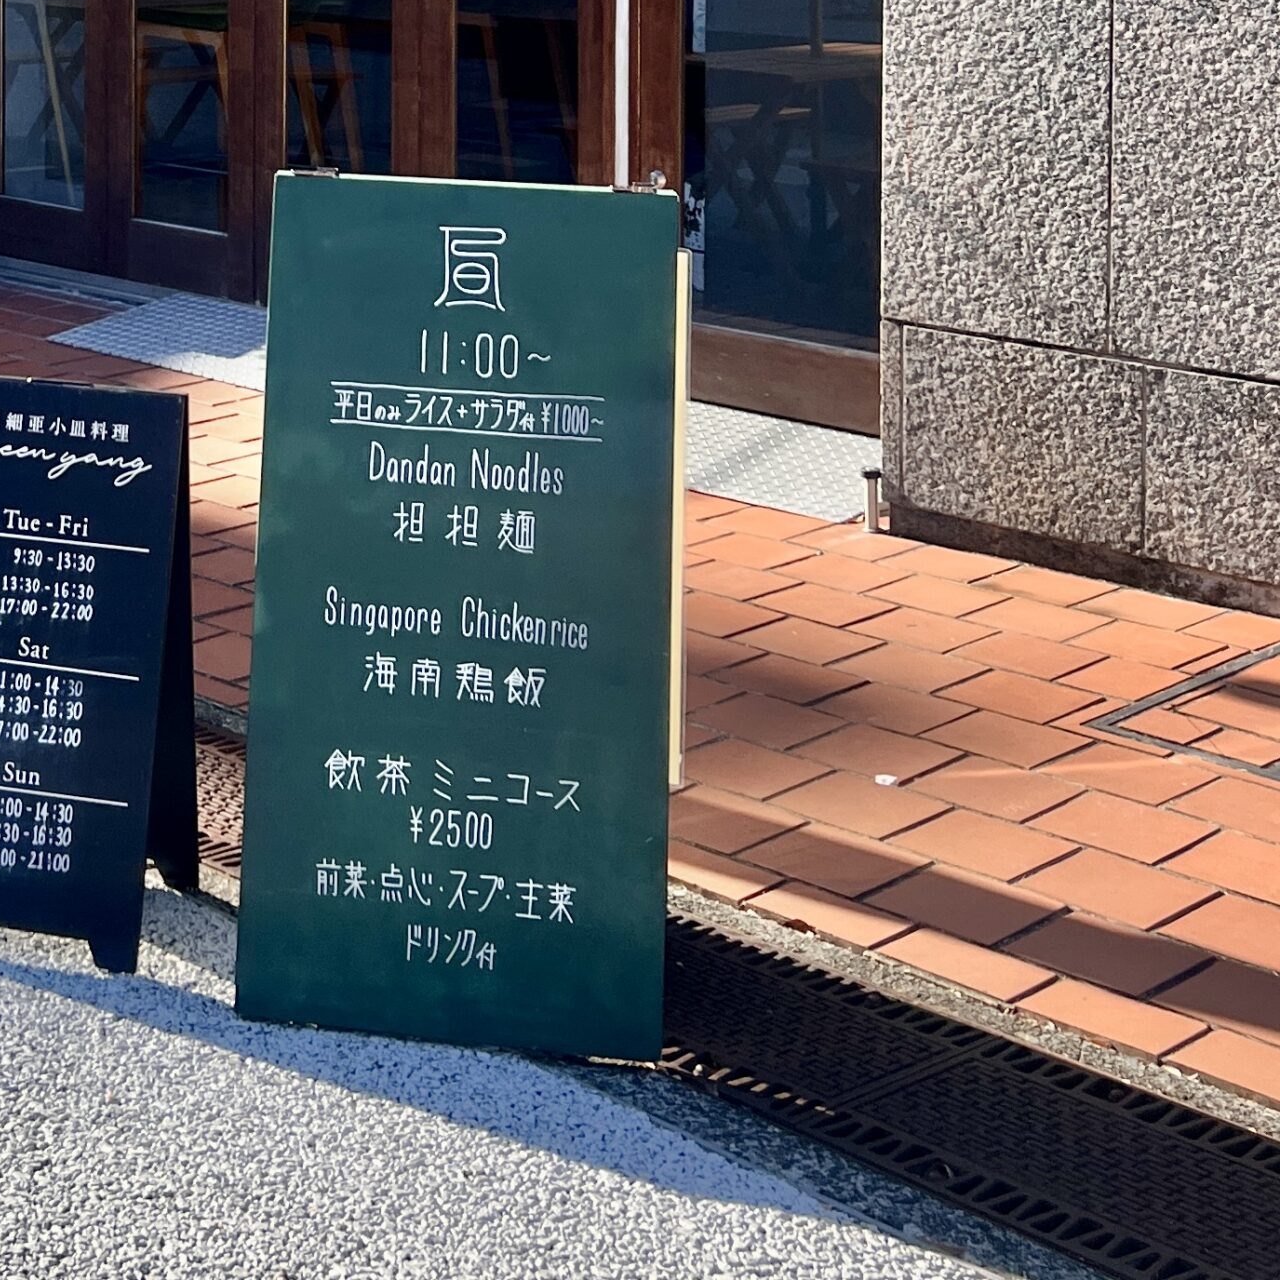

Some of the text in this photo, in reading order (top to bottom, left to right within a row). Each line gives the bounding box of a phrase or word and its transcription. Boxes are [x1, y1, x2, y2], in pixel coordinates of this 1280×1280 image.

[47, 451, 153, 487] yang
[369, 440, 565, 496] Dandan Noodles
[3, 508, 41, 532] Tue
[59, 515, 89, 537] Fri
[324, 585, 442, 637] Singapore
[18, 636, 50, 660] Sat
[363, 651, 547, 708] 海南鶏飯
[2, 761, 40, 786] Sun
[409, 805, 494, 850] ¥2500
[406, 924, 497, 971] ドリンク付
